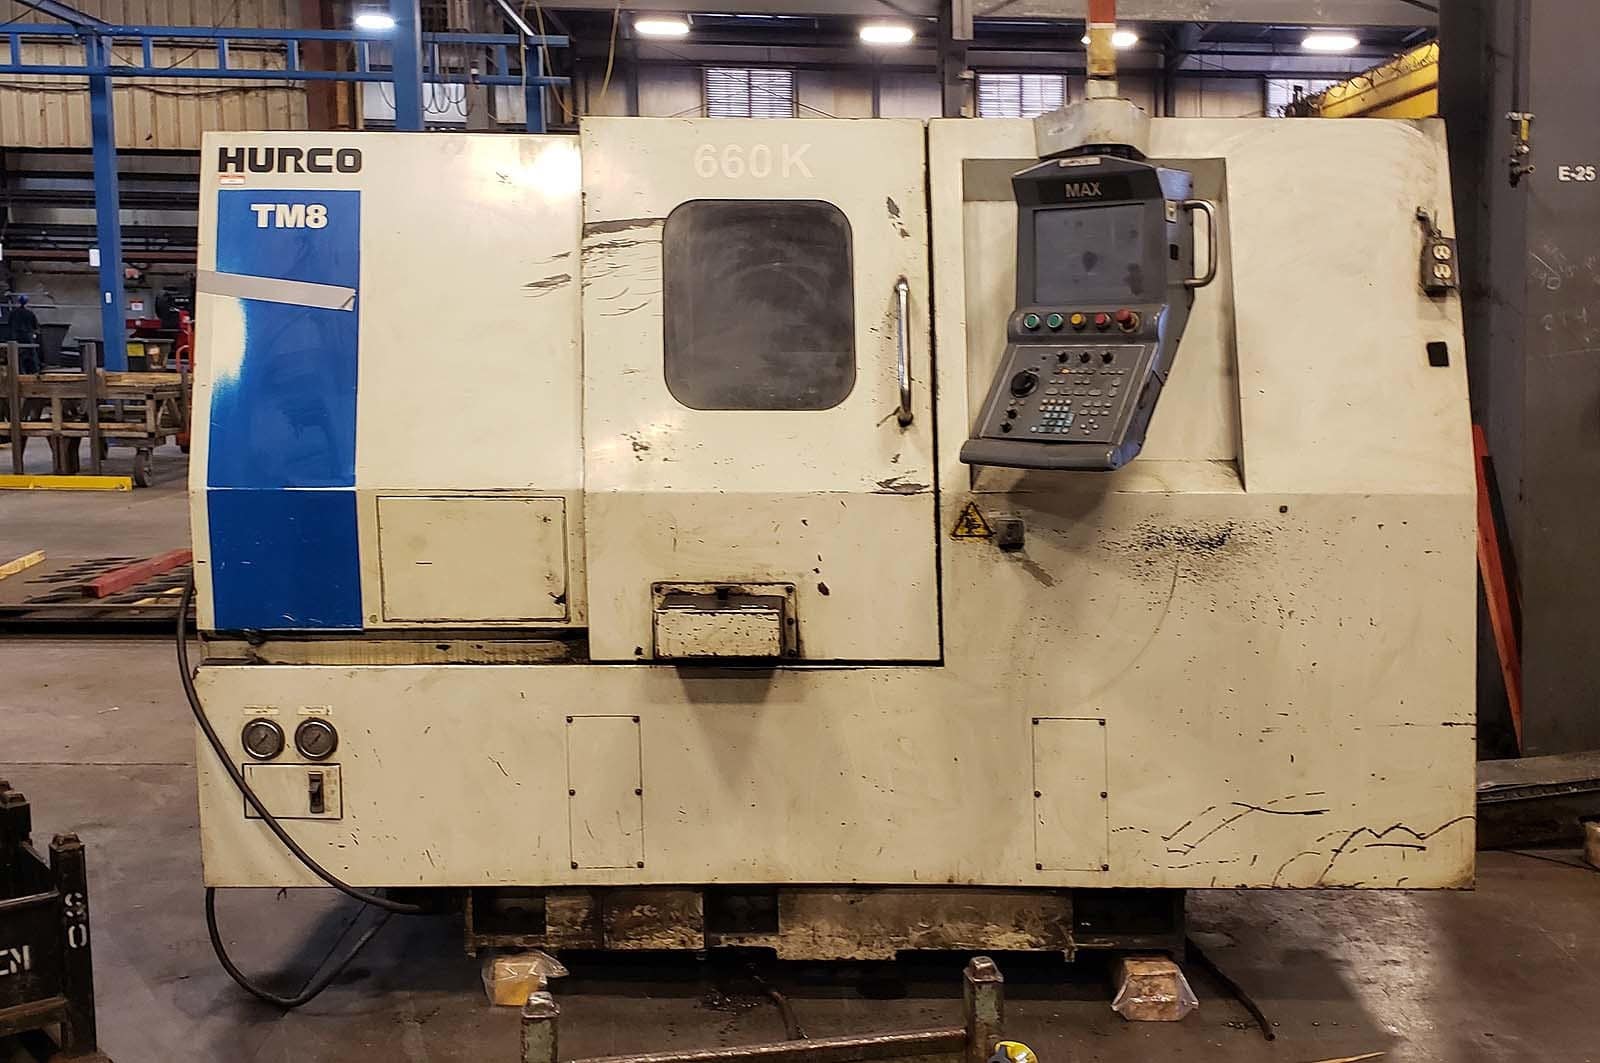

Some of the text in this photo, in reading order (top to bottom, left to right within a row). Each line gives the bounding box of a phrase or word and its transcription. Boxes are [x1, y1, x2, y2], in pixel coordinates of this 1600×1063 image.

[218, 147, 362, 174] HURCO
[1558, 165, 1596, 182] E-25
[1064, 181, 1103, 198] MAX
[250, 203, 328, 229] TM8
